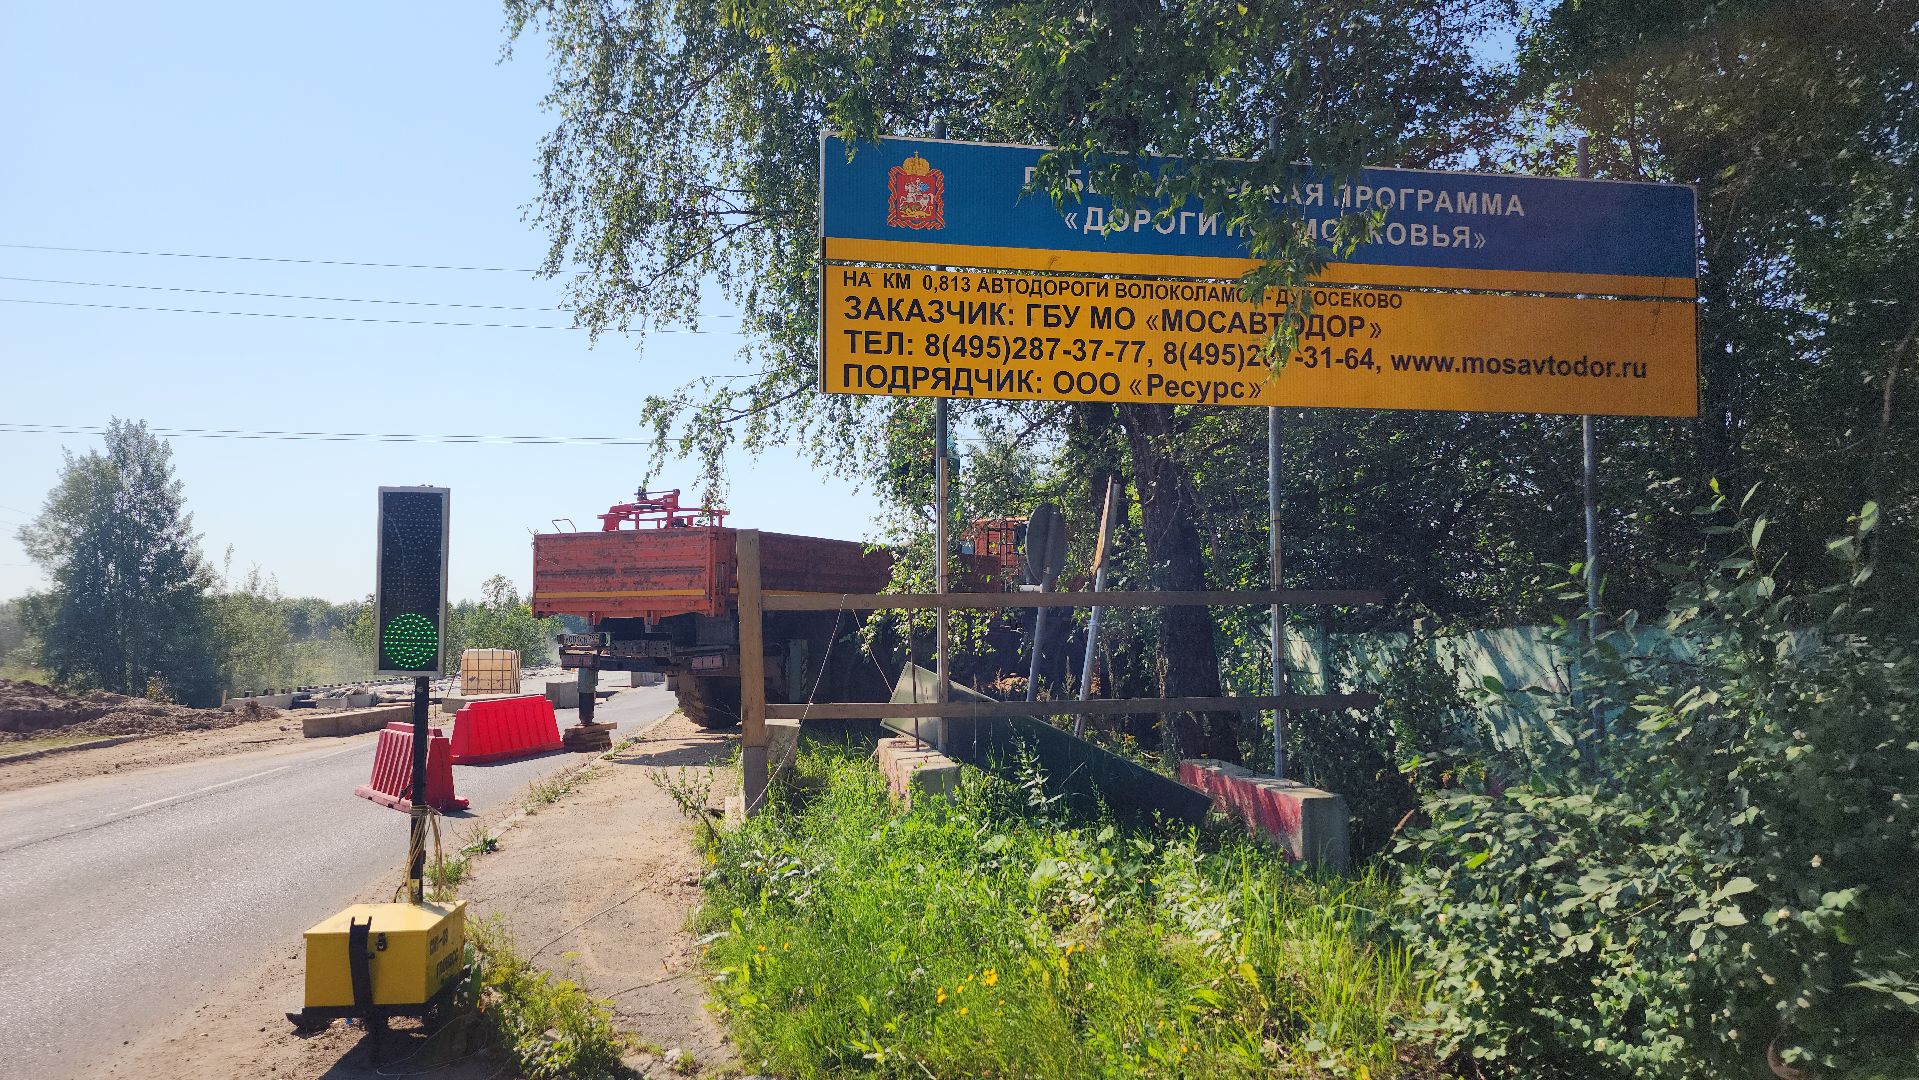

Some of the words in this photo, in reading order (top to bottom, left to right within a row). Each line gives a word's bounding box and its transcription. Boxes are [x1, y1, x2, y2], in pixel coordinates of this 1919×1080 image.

[1333, 184, 1525, 217] ПРОГРАММА
[1064, 206, 1217, 236] «ДОРОГИ
[843, 270, 872, 288] НА
[883, 272, 911, 290] КМ
[922, 274, 971, 294] 0,813
[976, 276, 1109, 299] АВТОДОРОГИ
[1115, 283, 1263, 304] ВОЛОКОЛАМС
[1275, 289, 1403, 309] ДУОСЕКОВО
[843, 295, 1014, 326] ЗАКАЗЧИК:
[1026, 303, 1081, 329] ГБУ
[1090, 305, 1136, 331] МО
[843, 329, 913, 356] ТЕЛ:
[924, 333, 1153, 368] 8(495)287-37-77,
[1163, 341, 1382, 374] 8(495)2-31-64,
[1390, 354, 1648, 379] www.mosavtodor.ru
[843, 363, 1042, 396] ПОДРЯДЧИК:
[1053, 370, 1121, 395] ООО
[1129, 372, 1262, 403] «Ресурс»
